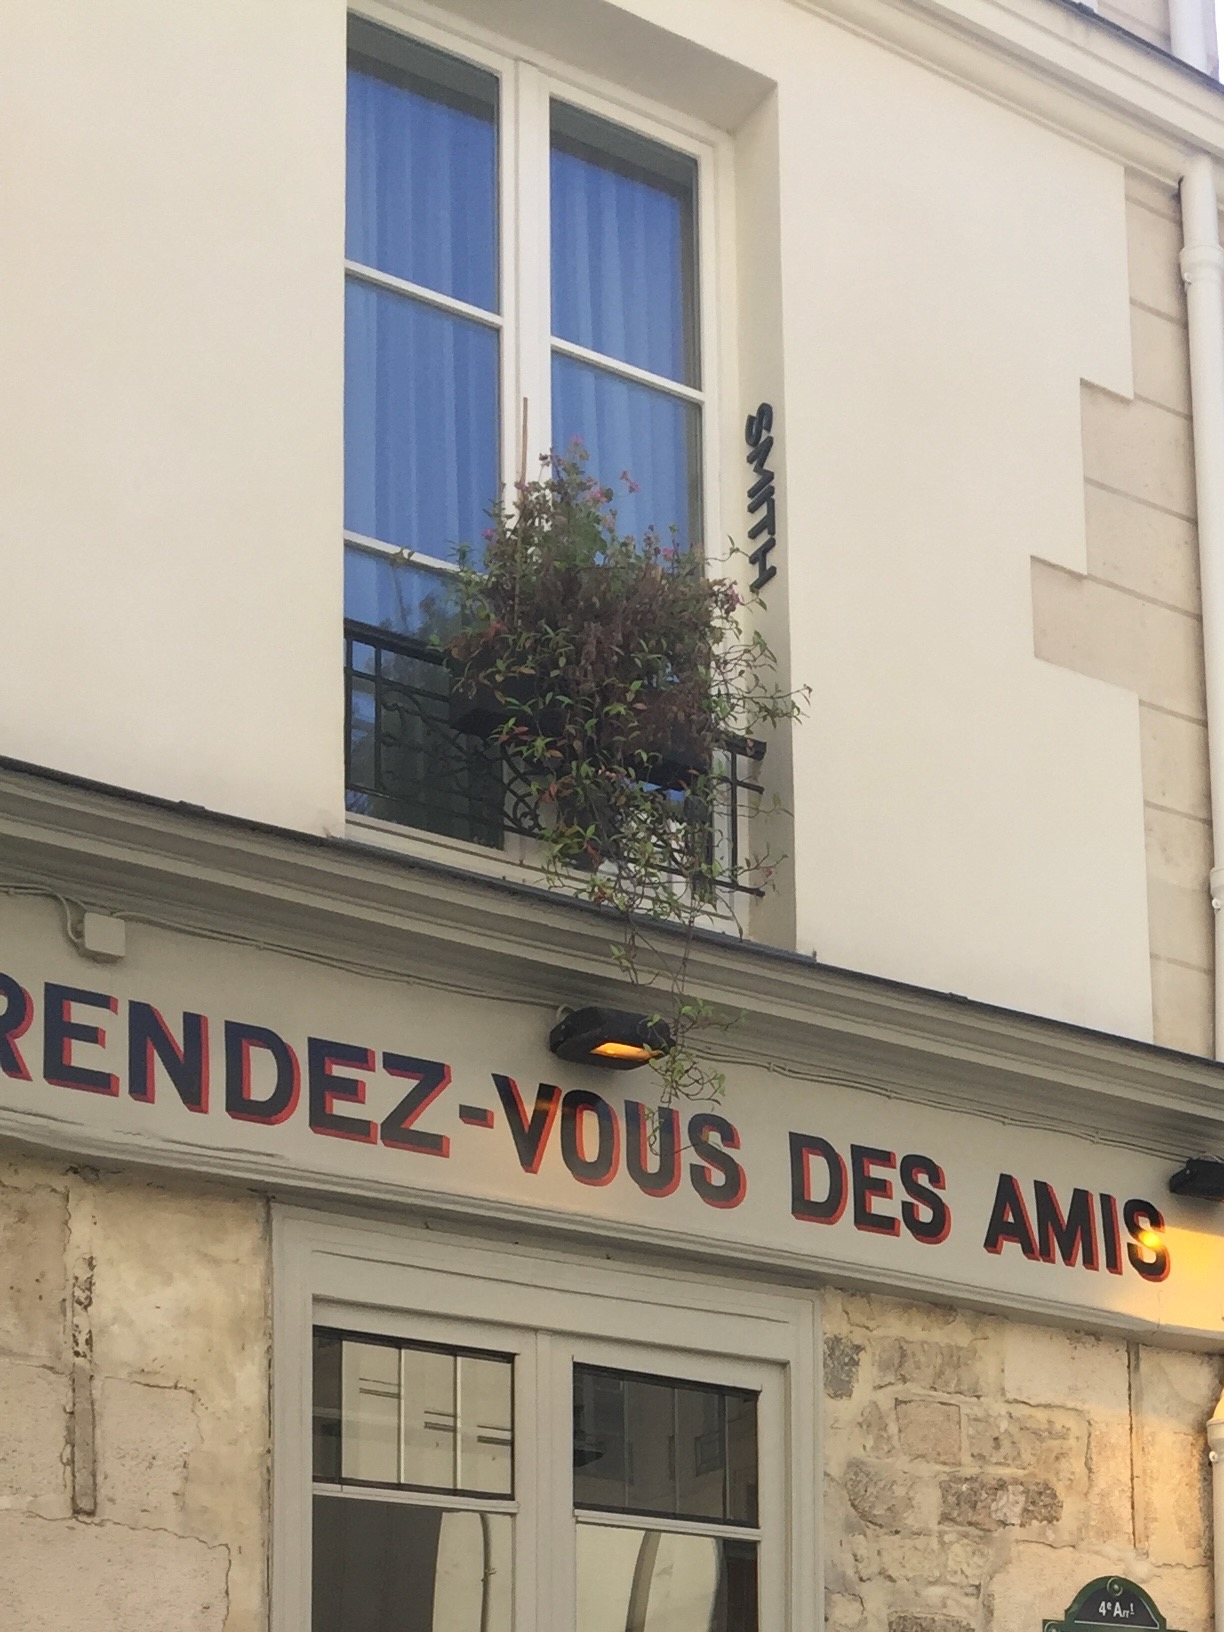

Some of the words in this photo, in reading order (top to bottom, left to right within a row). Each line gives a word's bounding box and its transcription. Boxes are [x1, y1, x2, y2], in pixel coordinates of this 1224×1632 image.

[745, 402, 777, 593] SMITH
[788, 1131, 952, 1245] DES
[983, 1173, 1171, 1282] AMIS
